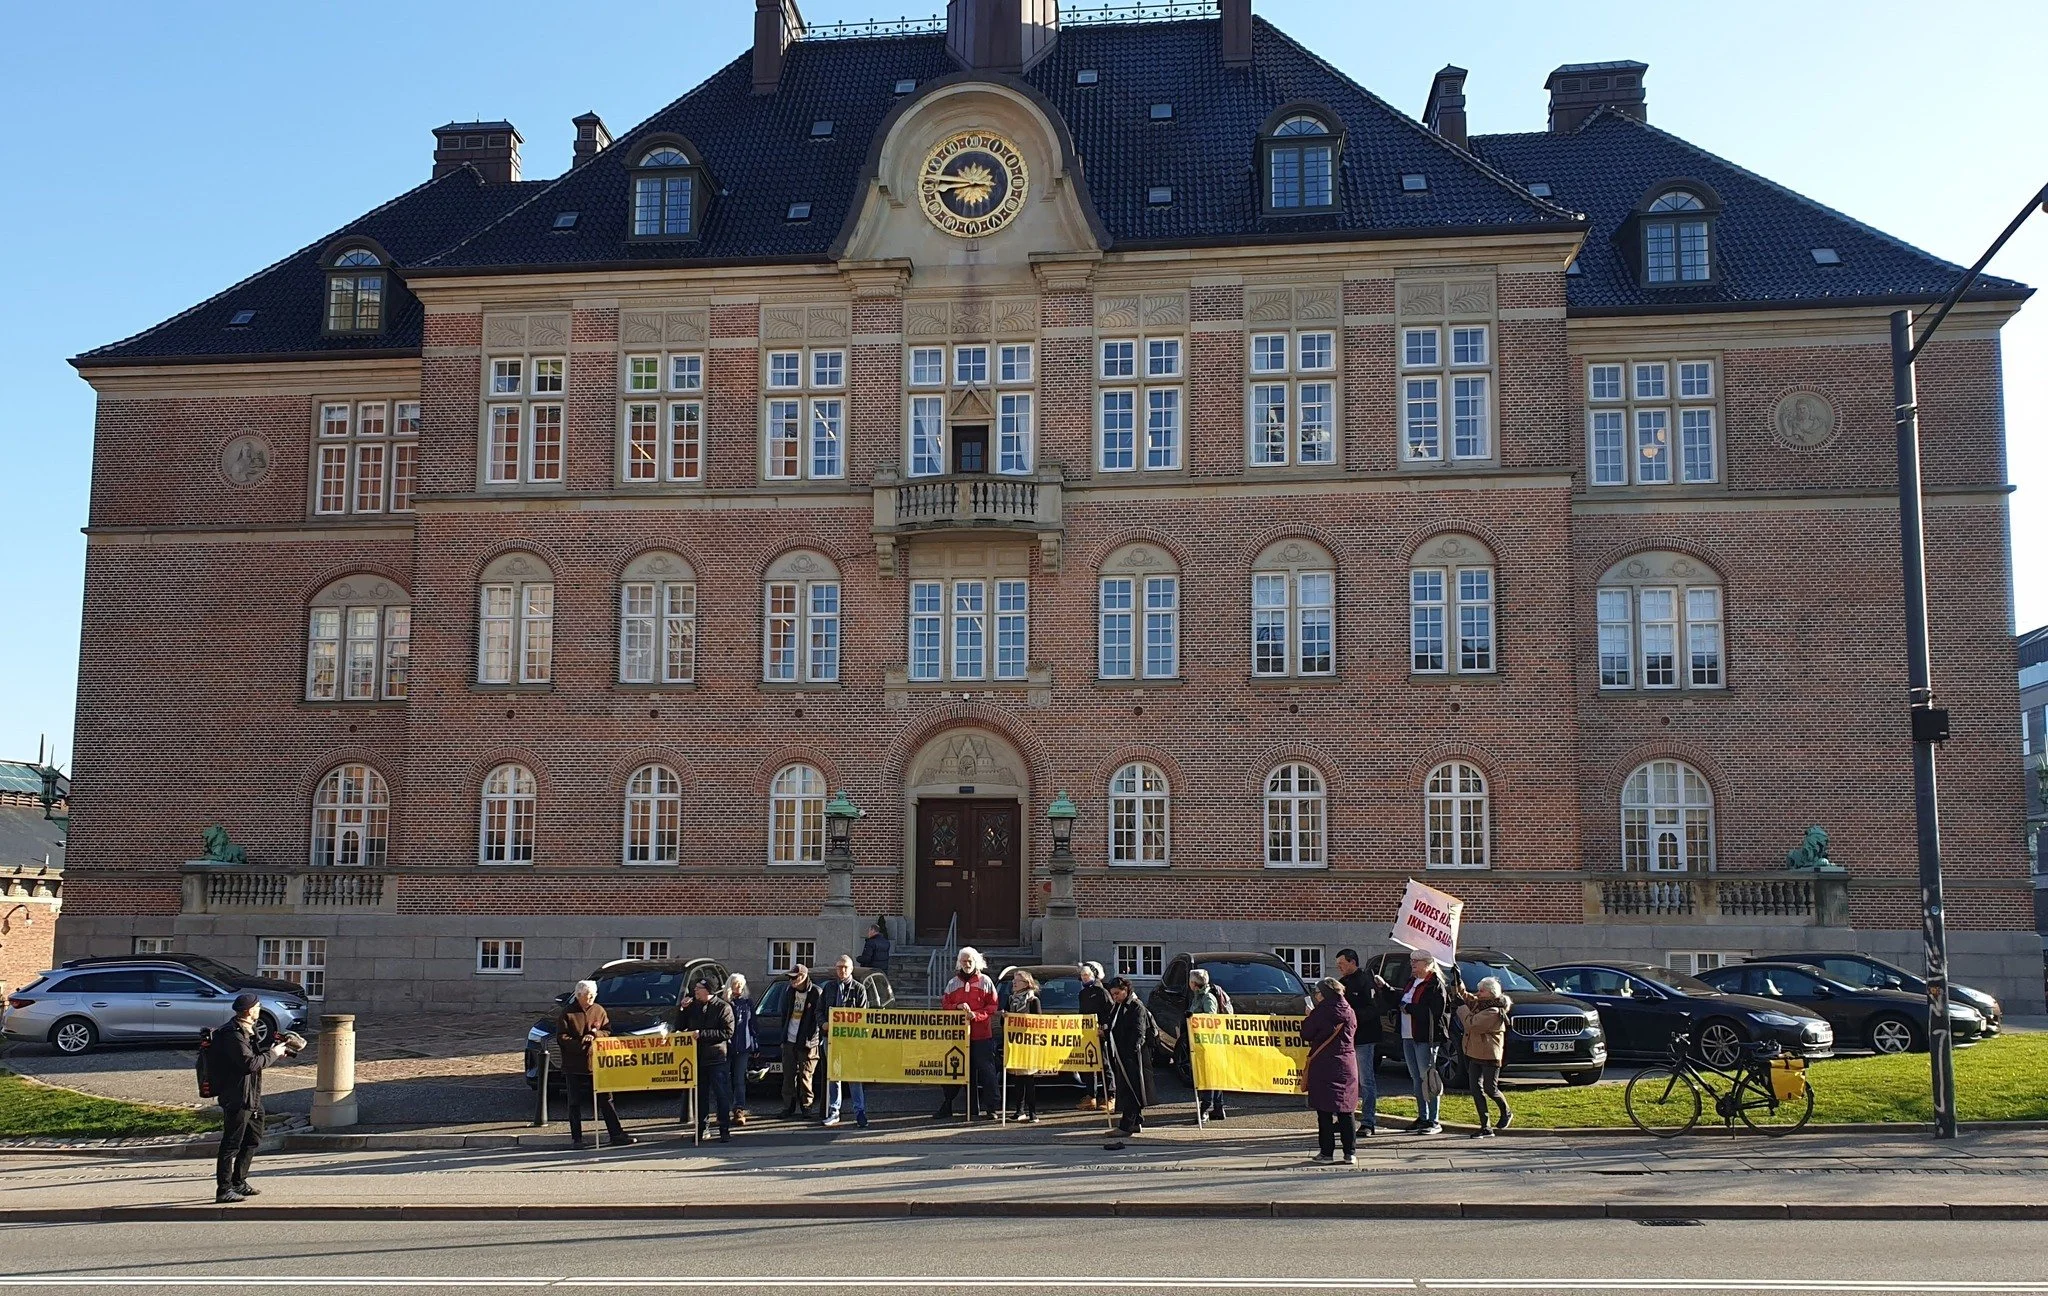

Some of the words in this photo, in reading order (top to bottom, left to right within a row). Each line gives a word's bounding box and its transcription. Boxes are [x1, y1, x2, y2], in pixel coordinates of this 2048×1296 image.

[1413, 899, 1441, 921] VORES
[1406, 914, 1427, 933] IKKE
[1425, 924, 1438, 939] TIL
[832, 1011, 862, 1024] STOP
[866, 1013, 966, 1026] NEDRIVNINGERNE
[1008, 1017, 1058, 1030] FINGRENE
[1061, 1019, 1080, 1030] VÆK
[1191, 1017, 1222, 1030] STOP
[1225, 1019, 1303, 1032] NEDRIVNING
[832, 1026, 868, 1039] BEVAR
[871, 1028, 917, 1040] ALMENE
[920, 1029, 966, 1041] BOLIGER
[1007, 1031, 1048, 1047] VORES
[1051, 1034, 1082, 1048] HJEM
[1193, 1032, 1231, 1046] BEVAR
[1234, 1034, 1282, 1048] ALMENE
[1285, 1036, 1312, 1048] BOL
[596, 1037, 647, 1051] FINGRENE
[674, 1035, 693, 1047] FRA
[1539, 1042, 1548, 1050] CY
[1549, 1042, 1559, 1050] 93
[1560, 1041, 1574, 1050] 784
[597, 1053, 638, 1069] VORES
[641, 1051, 674, 1066] HJEM
[918, 1060, 943, 1068] ALMEN
[904, 1068, 943, 1077] MODSTAND
